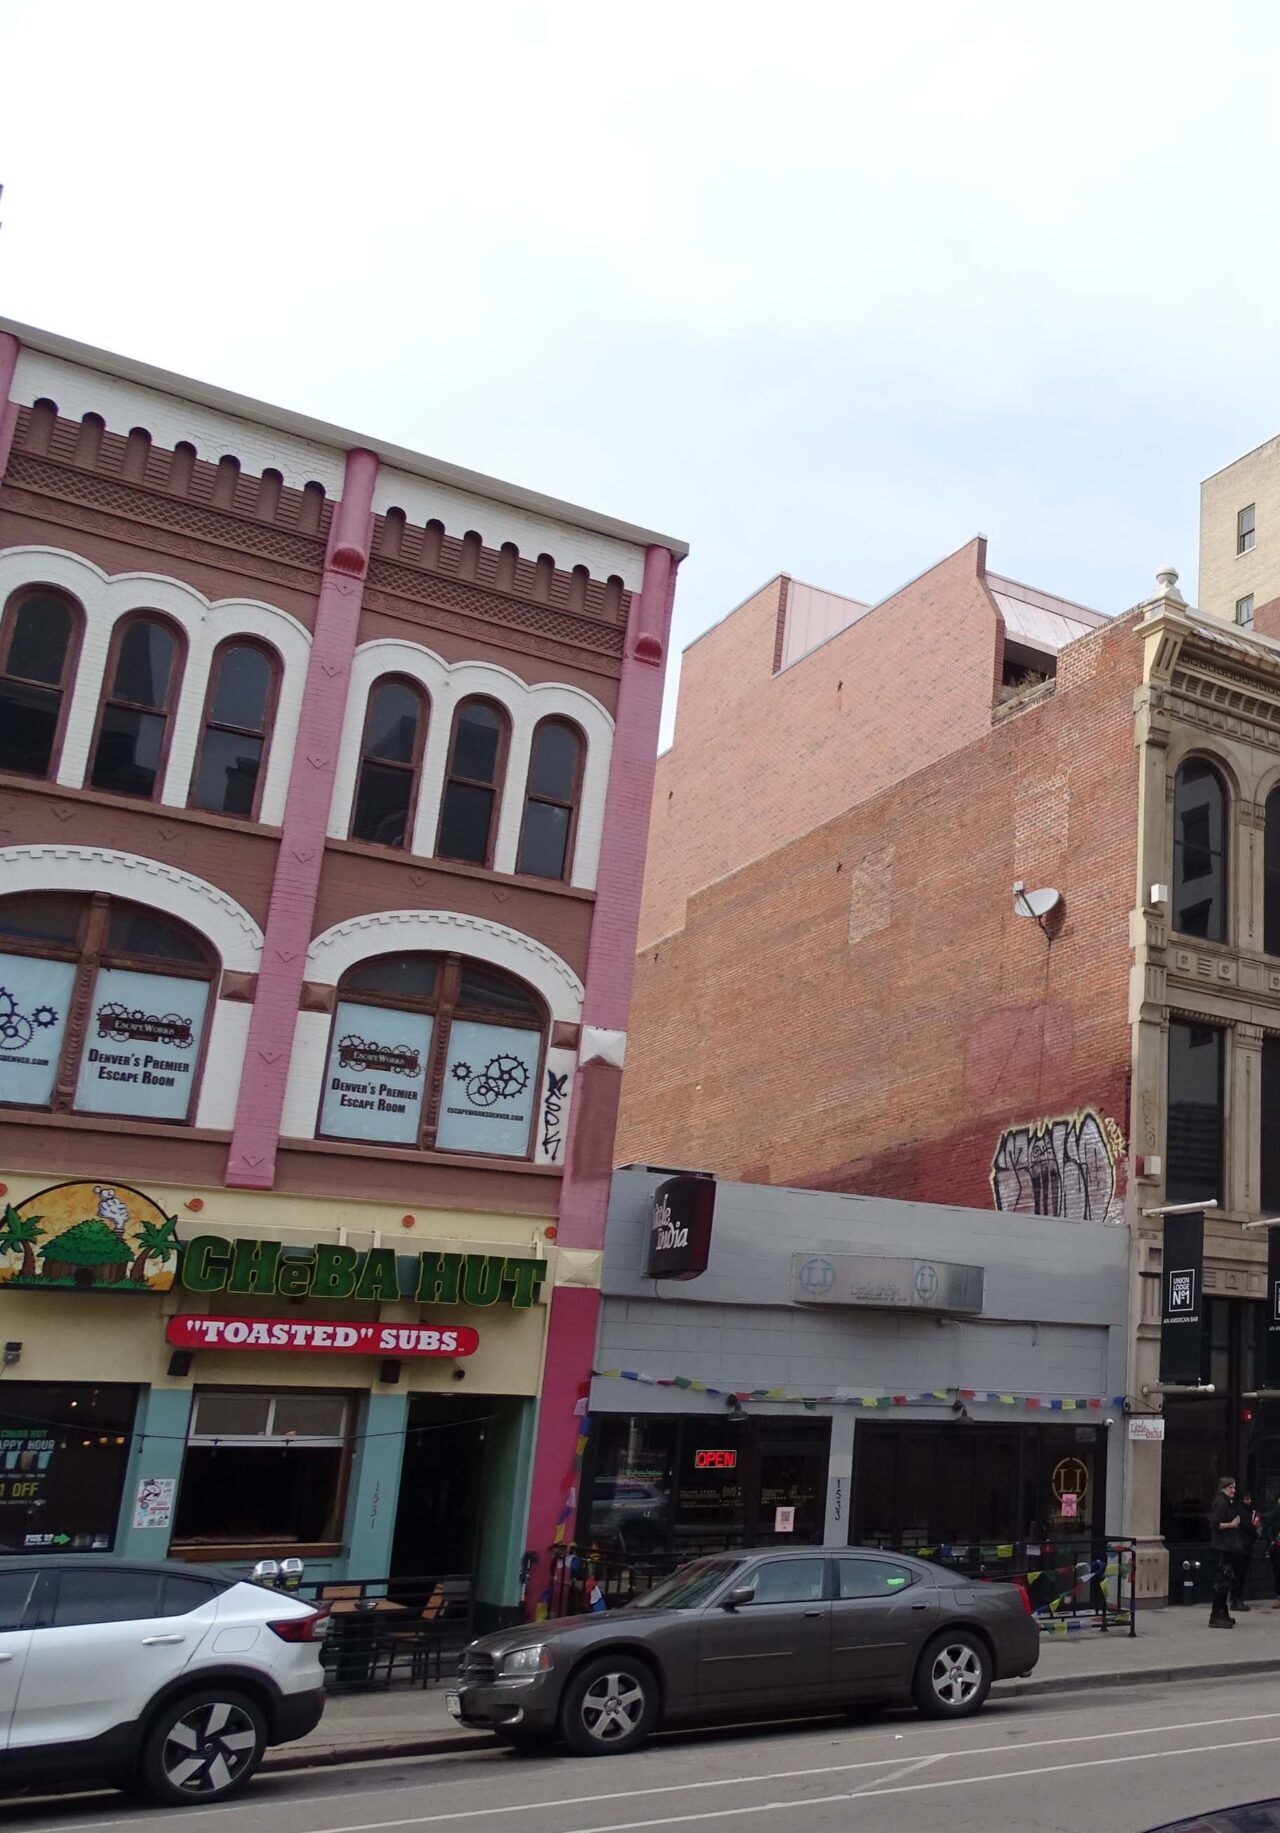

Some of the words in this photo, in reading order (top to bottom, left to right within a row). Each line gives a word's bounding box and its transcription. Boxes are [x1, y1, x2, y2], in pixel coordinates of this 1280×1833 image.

[415, 1251, 549, 1310] HUT
[1173, 1276, 1190, 1285] UNION
[1173, 1283, 1190, 1291] LODGE
[186, 1320, 374, 1348] "TOASTED"
[379, 1328, 459, 1352] SUBS
[27, 1440, 55, 1450] HOUR
[696, 1451, 736, 1467] OPEN
[12, 1482, 39, 1497] OFF
[370, 1480, 380, 1529] 1531
[834, 1479, 842, 1521] 1533
